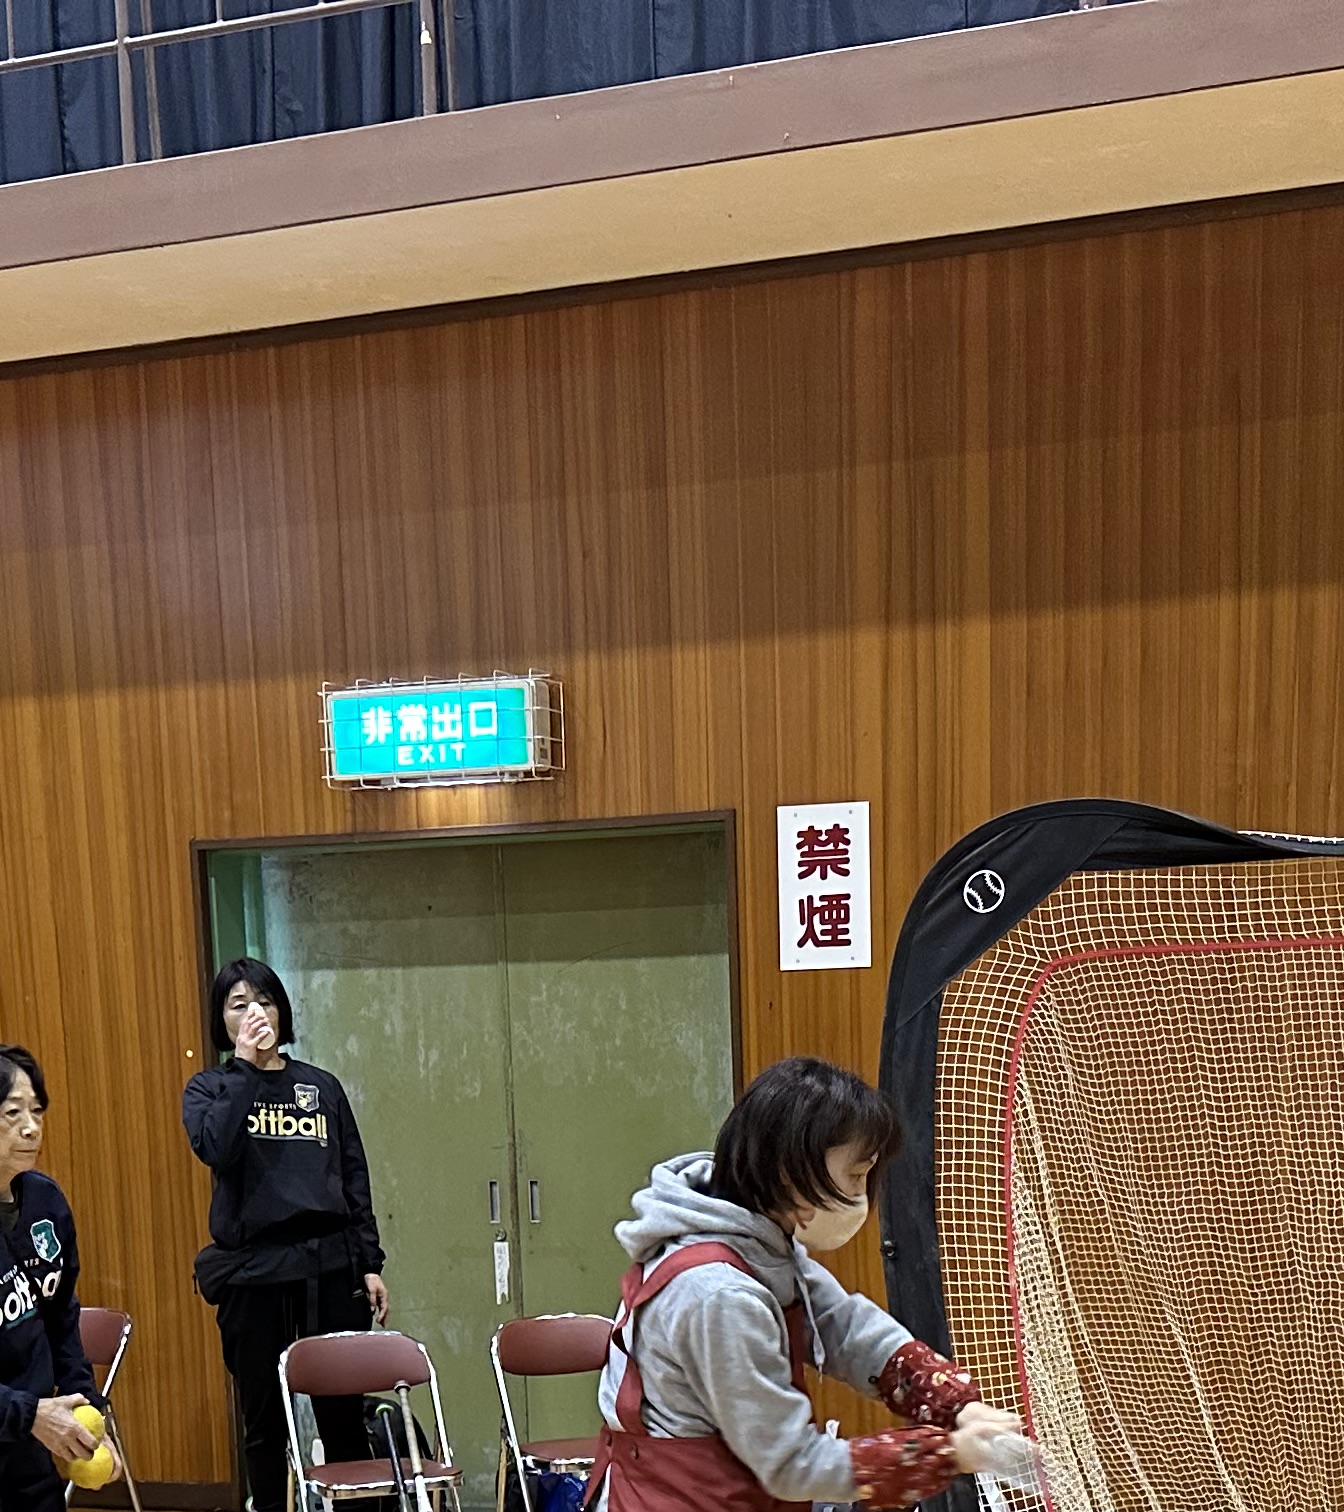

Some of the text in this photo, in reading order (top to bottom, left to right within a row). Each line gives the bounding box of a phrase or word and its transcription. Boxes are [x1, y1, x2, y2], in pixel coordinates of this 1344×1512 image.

[361, 701, 498, 745] 非常出口
[397, 742, 467, 766] EXIT
[795, 823, 852, 949] 禁煙
[247, 1108, 328, 1140] oftball
